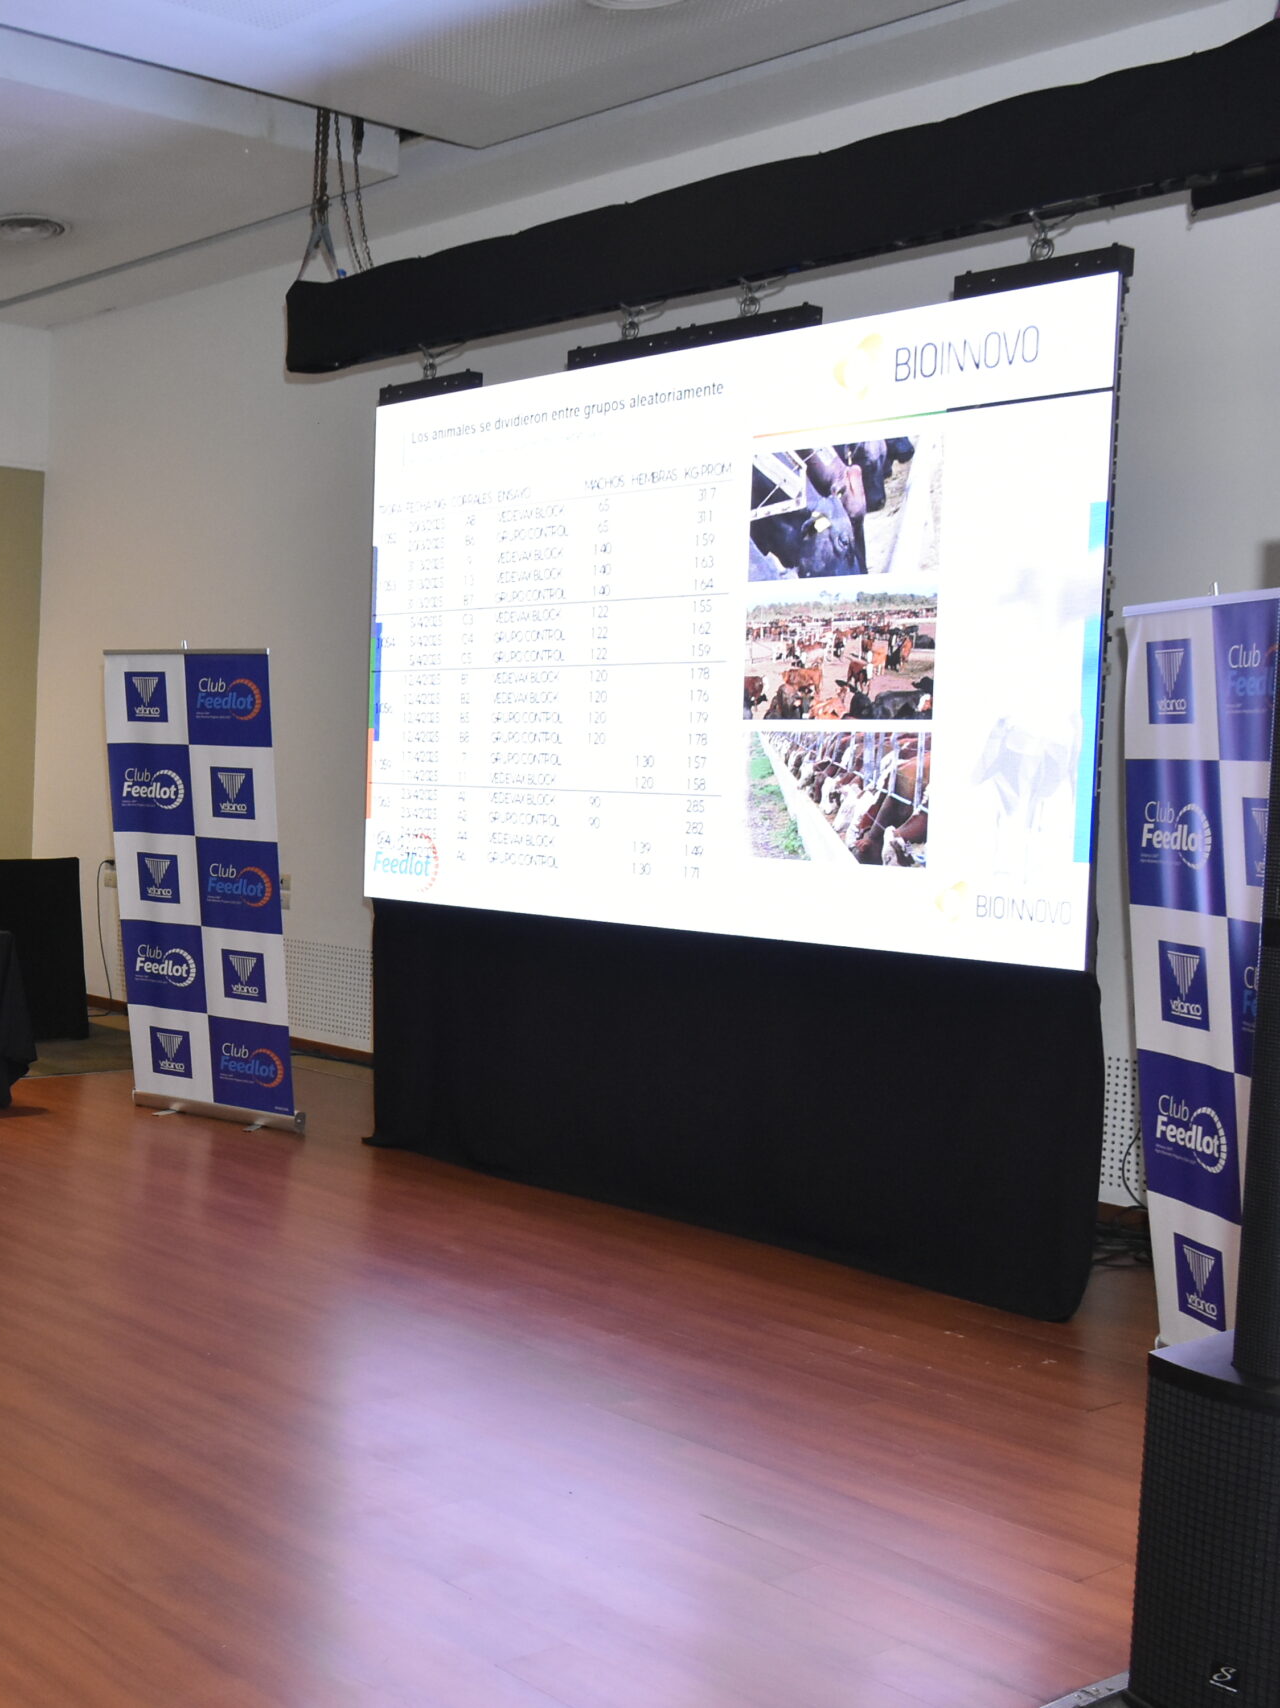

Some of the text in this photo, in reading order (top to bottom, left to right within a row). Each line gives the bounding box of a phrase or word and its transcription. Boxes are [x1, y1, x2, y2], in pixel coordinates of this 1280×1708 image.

[894, 325, 1039, 382] BIOINNOVO
[412, 382, 724, 444] Los animales se dividieron entre grupos aleatoriamente
[584, 474, 624, 490] MACHOS
[632, 468, 678, 485] HEMBRAS
[536, 504, 564, 519] BLOCK
[598, 498, 610, 512] 65
[698, 488, 716, 501] 317
[498, 529, 524, 542] GRUPO
[527, 525, 568, 540] CONTROL
[598, 520, 608, 533] 65
[698, 510, 712, 523] 311
[534, 547, 564, 560] BLOCK
[594, 542, 612, 555] 140
[696, 533, 715, 546] 159
[534, 568, 563, 580] BLOCK
[594, 564, 611, 576] 140
[696, 555, 714, 568] 163
[496, 590, 522, 602] GRUPO
[524, 588, 566, 600] CONTROL
[594, 584, 610, 596] 140
[694, 578, 714, 591] 164
[532, 608, 560, 622] BLOCK
[592, 605, 608, 618] 122
[694, 599, 712, 612] 155
[495, 631, 522, 643] GRUPO
[525, 629, 565, 642] CONTROL
[592, 626, 608, 639] 122
[692, 622, 711, 634] 162
[493, 651, 521, 664] GRUPO
[523, 649, 564, 662] CONTROL
[592, 648, 608, 660] 122
[692, 644, 711, 656] 159
[1228, 643, 1260, 668] Club
[198, 678, 226, 692] Club
[530, 671, 560, 684] BLOCK
[590, 670, 608, 682] 120
[691, 667, 710, 680] 178
[196, 692, 253, 710] Feedlot
[530, 692, 559, 704] BLOCK
[590, 691, 607, 703] 120
[690, 689, 709, 702] 176
[492, 712, 520, 724] GRUPO
[522, 712, 562, 724] CONTROL
[589, 712, 606, 724] 120
[690, 712, 708, 724] 179
[492, 732, 520, 744] GRUPO
[522, 732, 562, 744] CONTROL
[588, 732, 606, 744] 120
[689, 733, 708, 746] 178
[490, 752, 519, 764] GRUPO
[520, 752, 562, 766] CONTROL
[636, 754, 654, 768] 130
[688, 756, 706, 769] 157
[124, 768, 151, 783] Club
[528, 773, 556, 785] BLOCK
[636, 776, 654, 789] 120
[688, 778, 706, 790] 158
[122, 782, 176, 799] Feedlot
[527, 793, 555, 805] BLOCK
[589, 796, 601, 808] 90
[686, 800, 704, 812] 285
[1144, 800, 1175, 824] Club
[489, 812, 517, 824] GRUPO
[520, 813, 560, 826] CONTROL
[588, 816, 600, 829] 90
[686, 822, 704, 834] 282
[526, 834, 554, 846] BLOCK
[209, 864, 236, 878] Club
[373, 850, 432, 876] Feedlot
[488, 852, 516, 864] GRUPO
[518, 854, 558, 868] CONTROL
[632, 862, 651, 875] 130
[684, 866, 699, 879] 171
[208, 877, 264, 896] Feedlot
[976, 895, 1071, 925] BIOINNOVO
[137, 944, 162, 959] Club
[136, 958, 188, 978] Feedlot
[222, 1042, 248, 1058] Club
[220, 1056, 276, 1078] Feedlot
[1158, 1094, 1189, 1122] Club
[1156, 1114, 1220, 1158] Feedlot
